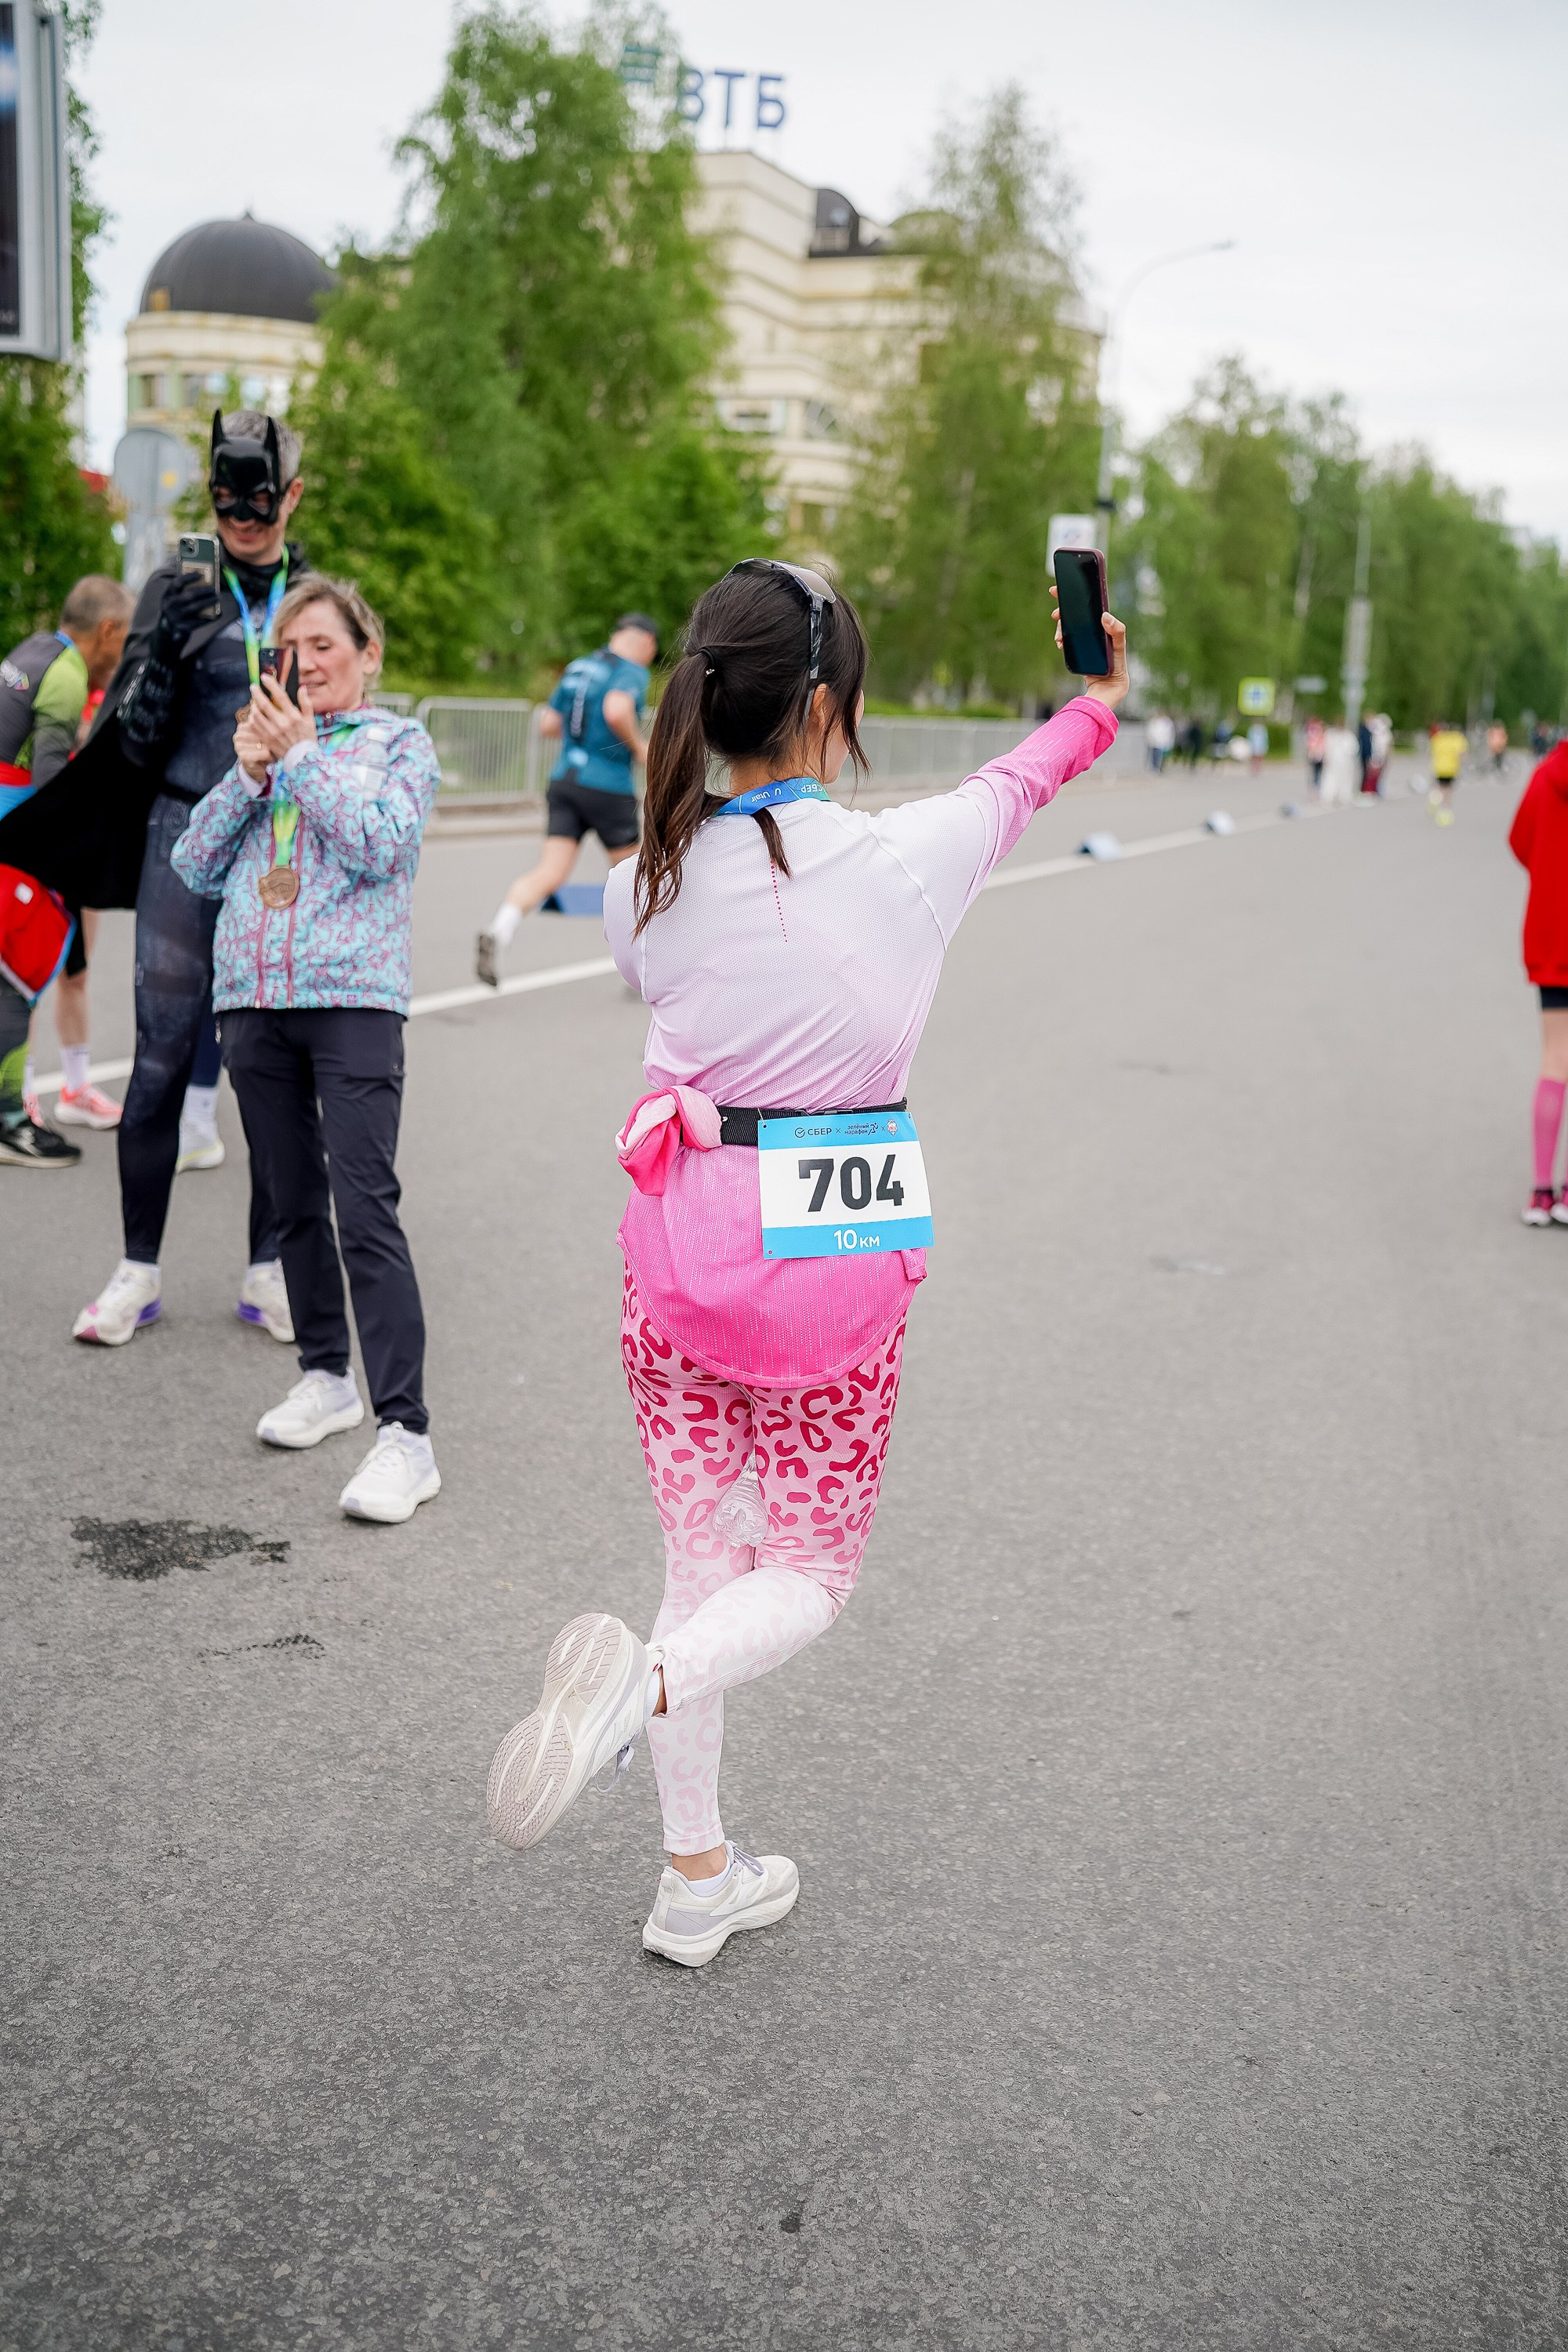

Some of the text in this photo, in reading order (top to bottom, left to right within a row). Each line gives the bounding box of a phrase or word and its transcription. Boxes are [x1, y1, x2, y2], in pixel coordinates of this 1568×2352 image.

[677, 67, 785, 129] ВТБ
[800, 784, 823, 793] СБЕР
[751, 791, 770, 803] Utair
[808, 1127, 833, 1136] СБЕР
[798, 1153, 905, 1213] 704
[833, 1229, 858, 1250] 10
